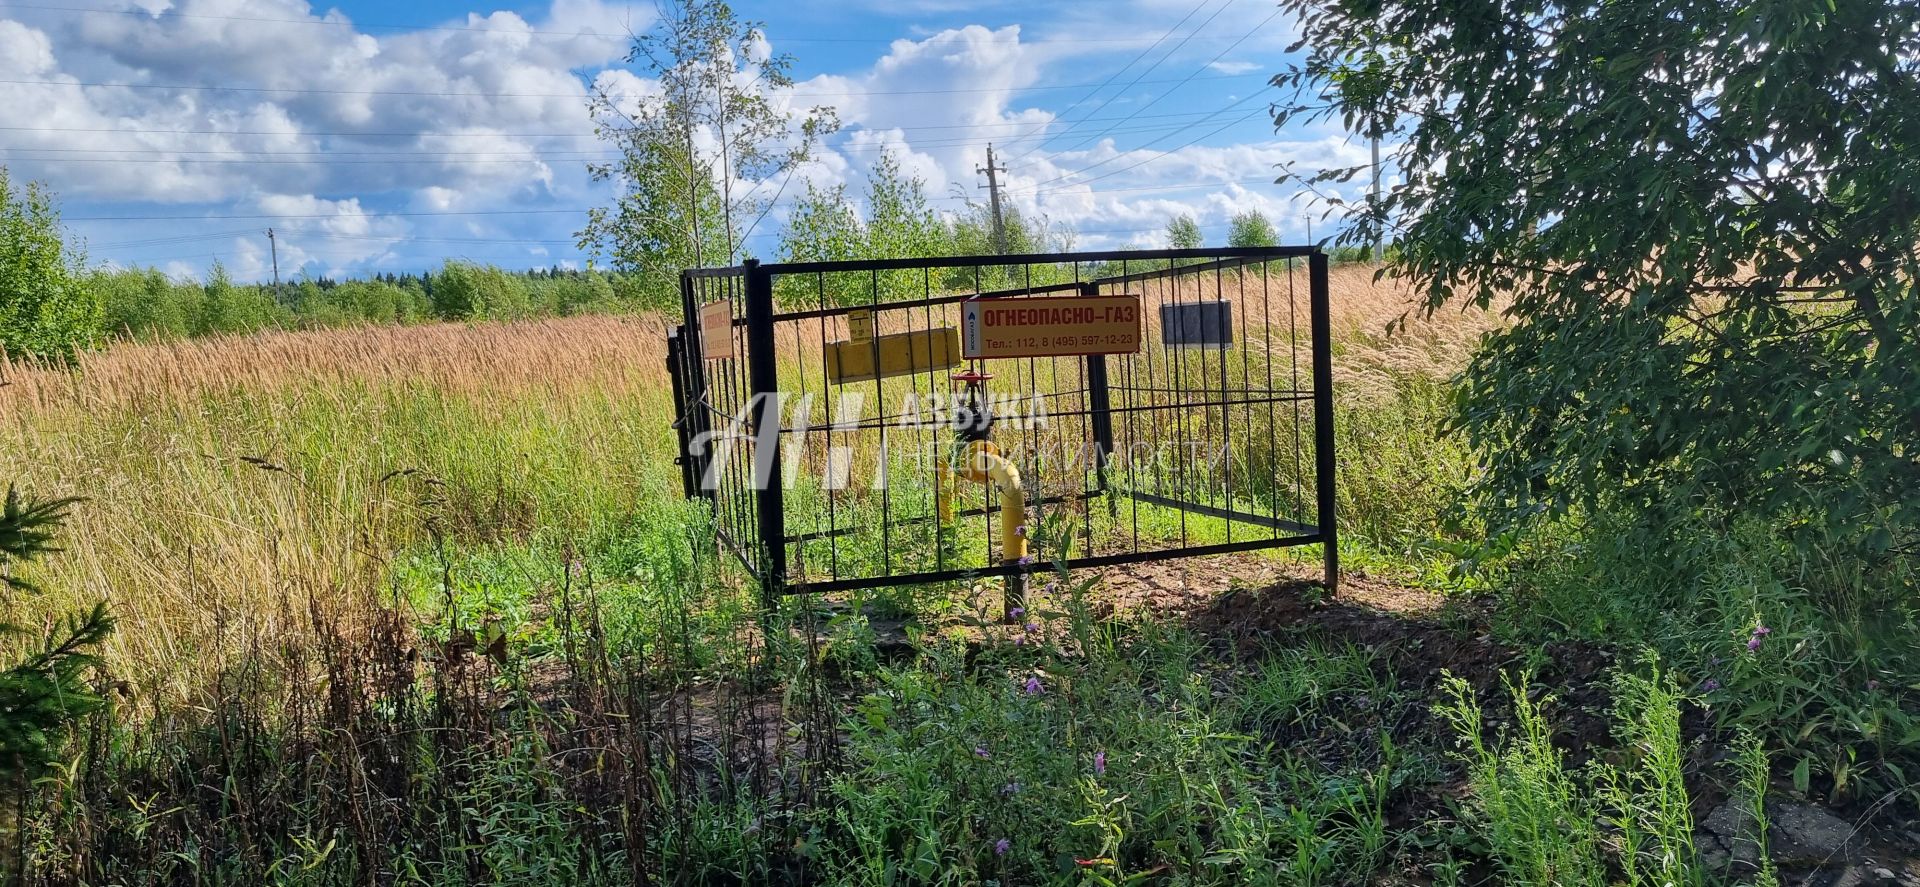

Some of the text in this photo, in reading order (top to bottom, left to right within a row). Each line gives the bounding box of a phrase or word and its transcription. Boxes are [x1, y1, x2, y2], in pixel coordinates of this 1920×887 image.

[986, 334, 1133, 348] Тел.: 112, 8 (495) 597-12-23
